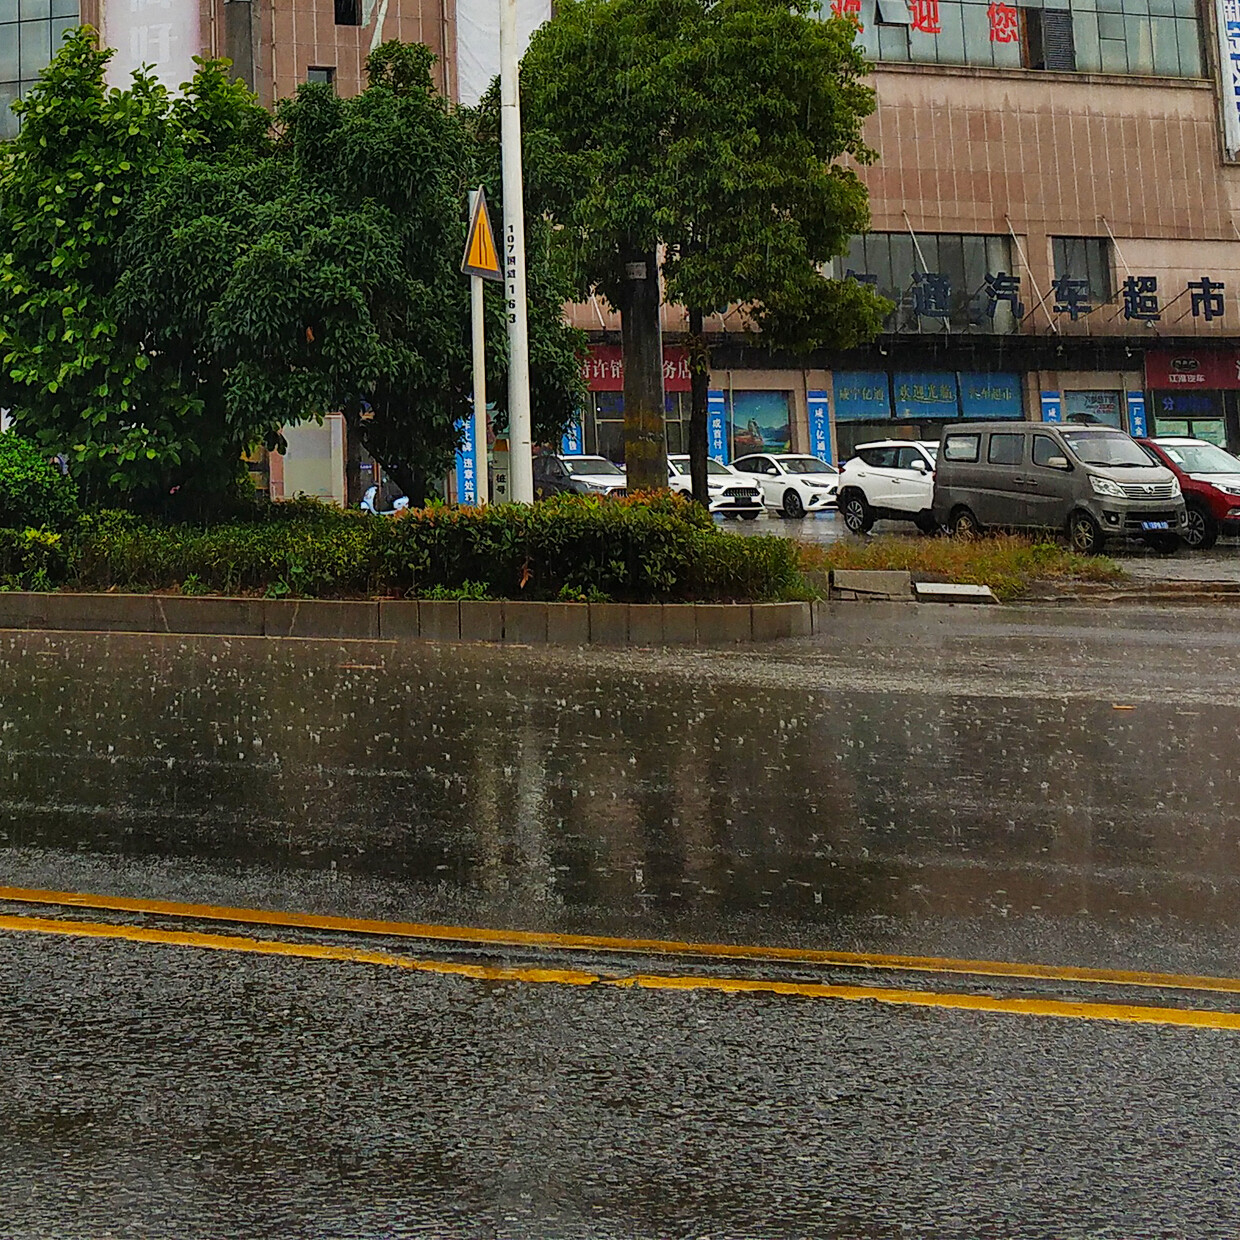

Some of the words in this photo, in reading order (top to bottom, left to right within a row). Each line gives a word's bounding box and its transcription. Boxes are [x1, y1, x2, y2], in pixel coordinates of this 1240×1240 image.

[845, 268, 1224, 322] 通汽车超市
[575, 359, 692, 379] 特许销务店
[1169, 373, 1206, 383] 江淮汽车
[711, 410, 723, 450] 一成首付
